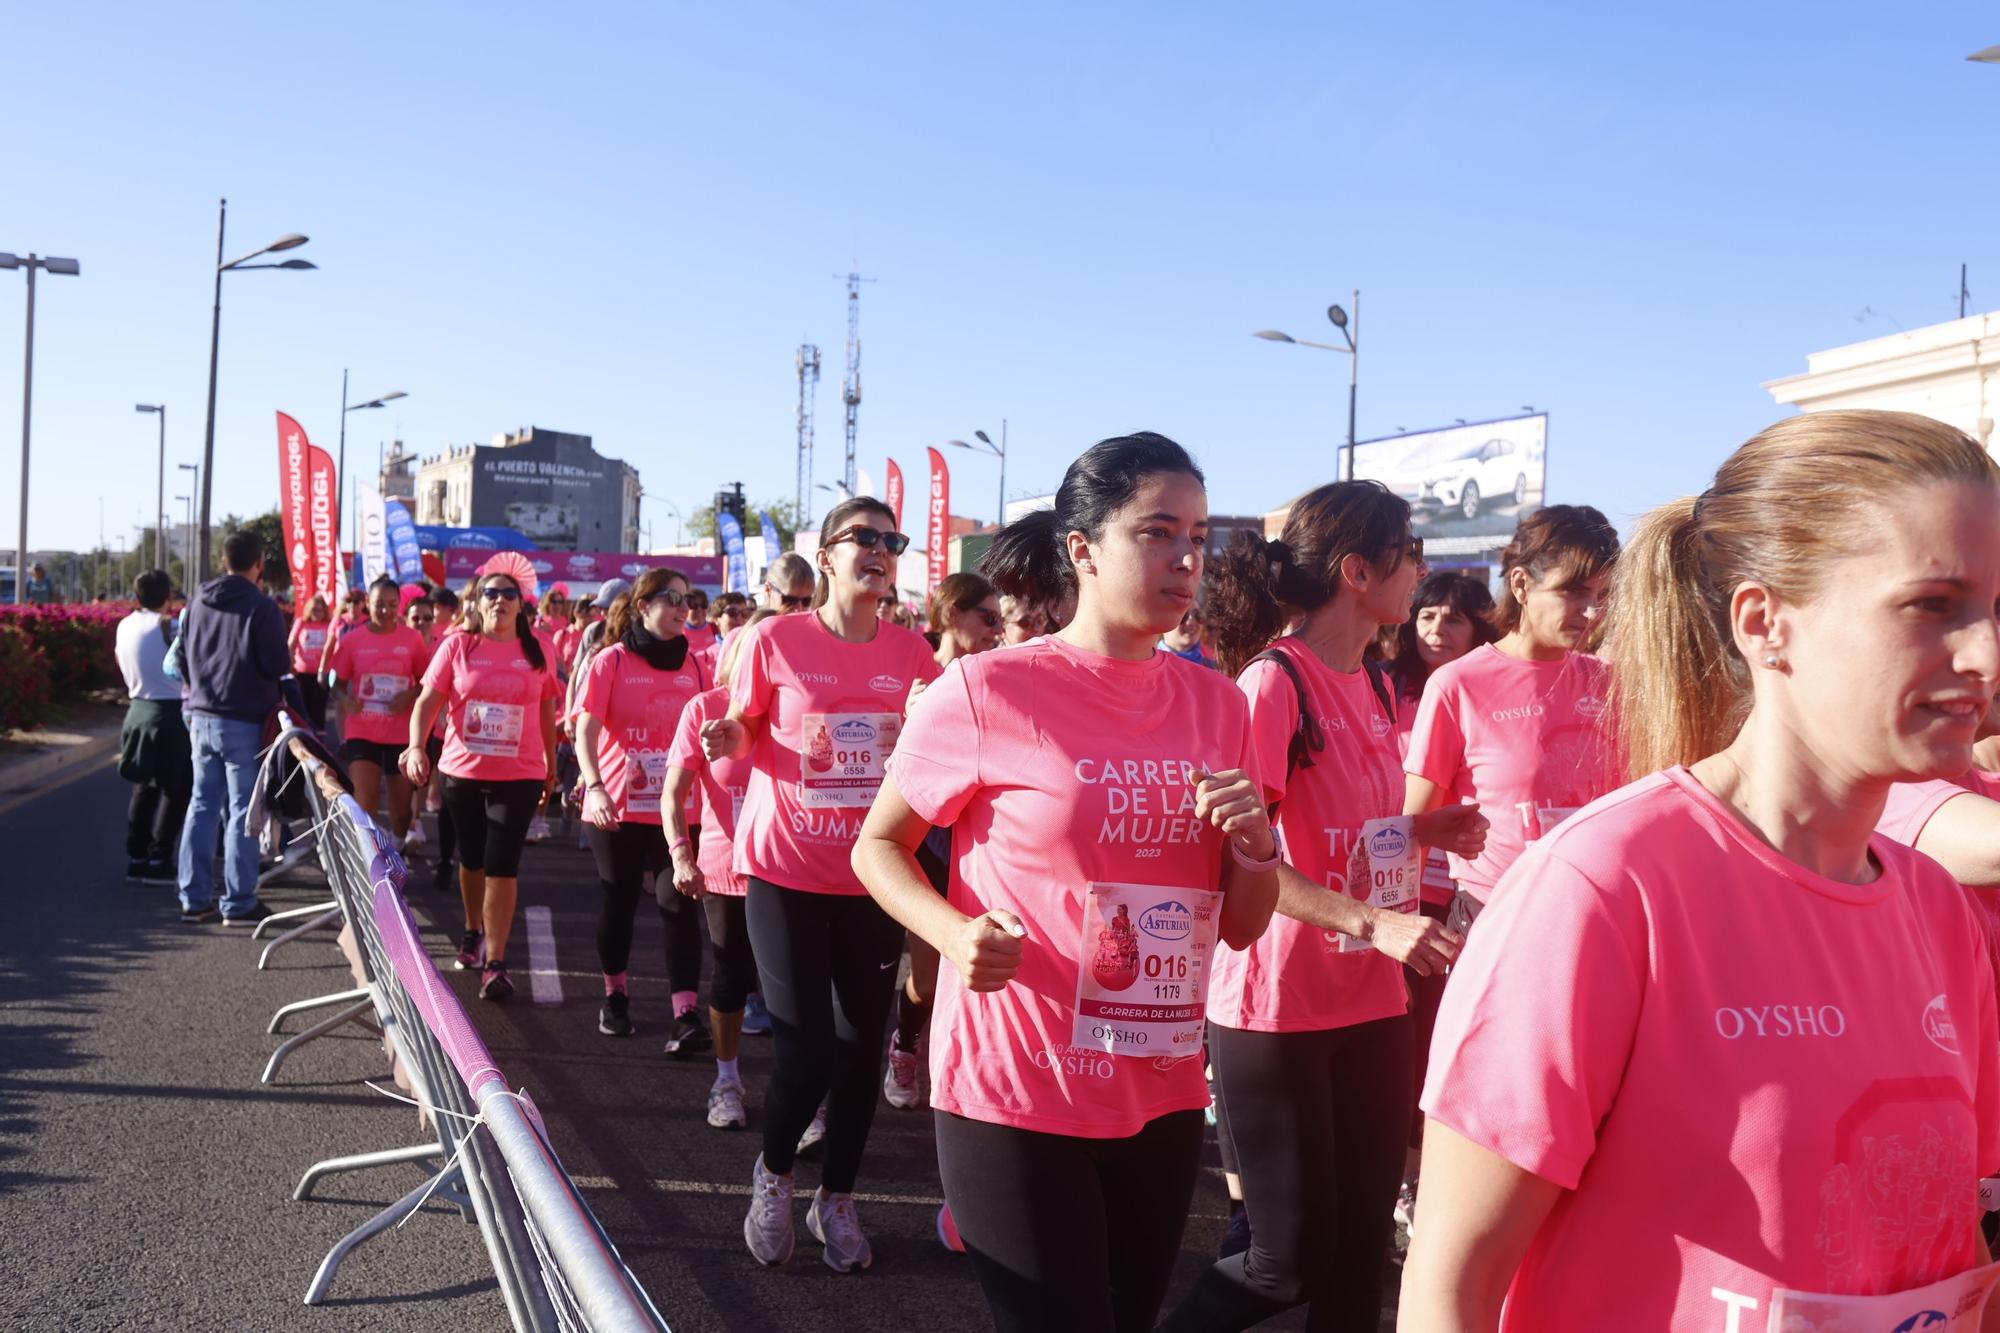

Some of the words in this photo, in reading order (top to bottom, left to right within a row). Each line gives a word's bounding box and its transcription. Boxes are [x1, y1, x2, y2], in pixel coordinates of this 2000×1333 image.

[497, 461, 537, 474] PUERTO
[795, 672, 838, 685] OYSHO
[1492, 704, 1544, 722] OYSHO
[626, 727, 648, 743] TU
[837, 750, 872, 764] 016
[843, 767, 866, 776] 6558
[811, 792, 844, 801] OYSHO
[1107, 787, 1149, 815] DE
[1161, 787, 1197, 815] LA
[792, 811, 862, 840] SUMA
[1097, 817, 1204, 844] MUJER
[1135, 848, 1162, 858] 2023
[1374, 867, 1404, 888] 016
[1144, 914, 1190, 931] ASTURIANA
[1144, 954, 1187, 978] 016
[1154, 984, 1180, 999] 1179
[1099, 1006, 1148, 1018] CARRERA
[1150, 1010, 1164, 1018] DE
[1165, 1010, 1174, 1018] LA
[1714, 1004, 1846, 1039] OYSHO
[1092, 1026, 1148, 1045] OYSHO
[1035, 1050, 1114, 1079] OYSHO
